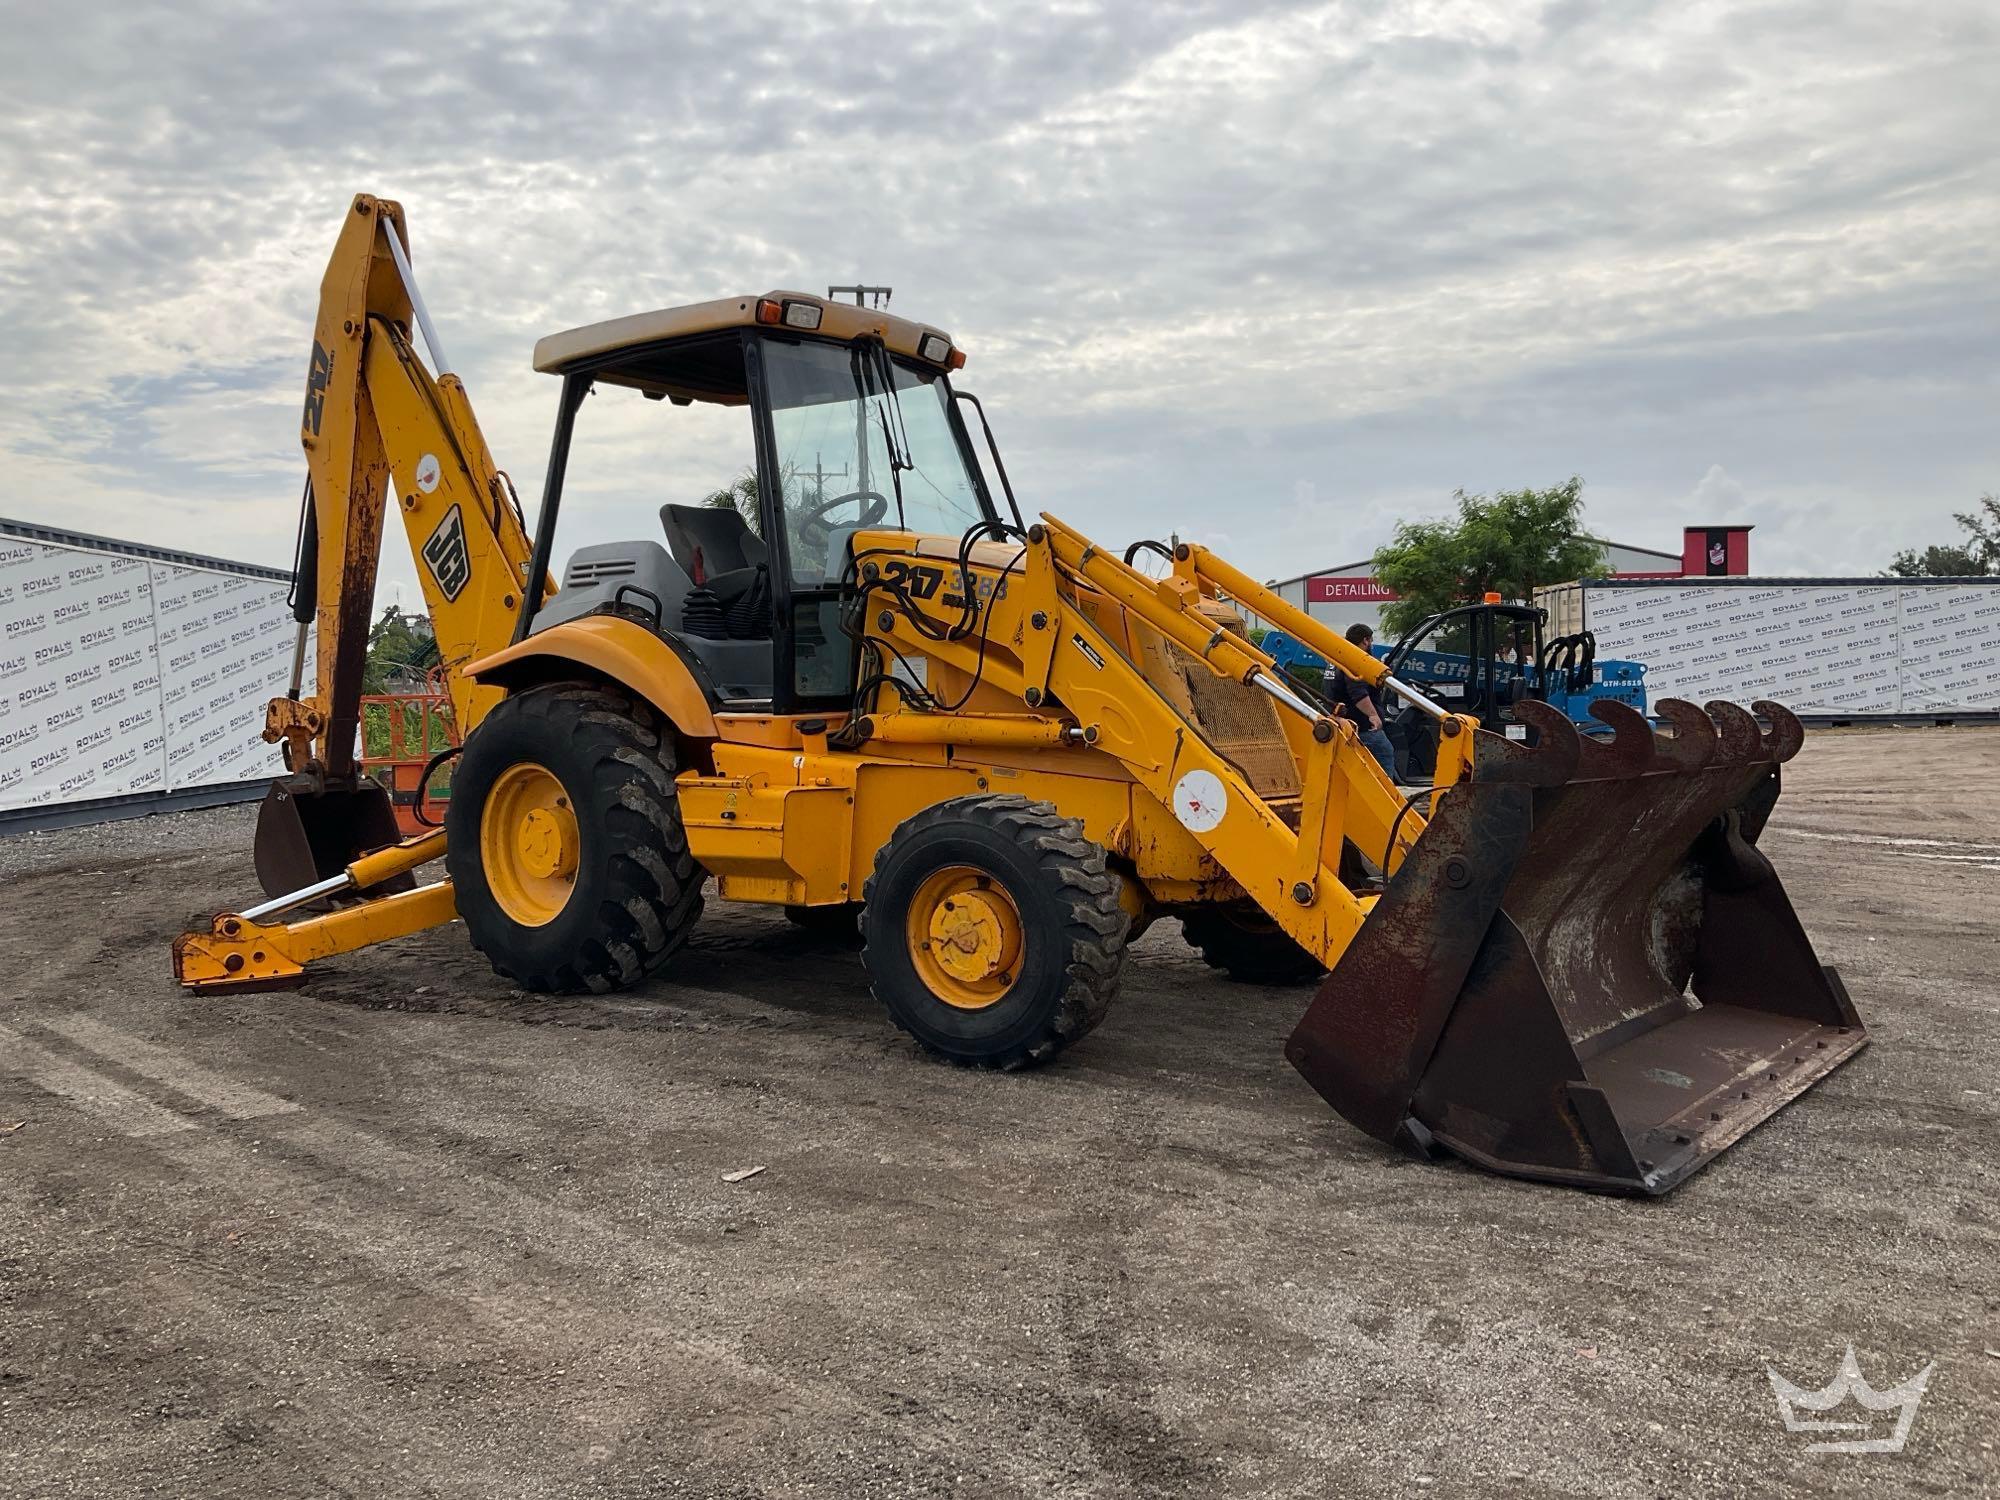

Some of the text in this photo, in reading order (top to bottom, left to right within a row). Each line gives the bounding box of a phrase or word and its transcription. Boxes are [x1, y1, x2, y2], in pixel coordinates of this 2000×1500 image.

[0, 549, 24, 560] OYAL
[425, 516, 466, 595] JCB
[69, 568, 96, 579] ROYAL
[882, 561, 944, 599] 217
[23, 579, 53, 592] ROYAL
[138, 584, 152, 593] ROY
[1325, 583, 1390, 597] DETAILING
[193, 588, 213, 598] ROYAL
[270, 590, 287, 599] ROYAL
[1680, 590, 1706, 598] ROYAL
[1749, 592, 1775, 600] ROYAL
[98, 592, 123, 605] ROYAL
[1636, 598, 1662, 606] ROYAL
[1815, 595, 1841, 603] ROYAL
[1949, 595, 1975, 604] ROYAL
[160, 599, 182, 609] ROYAL
[243, 600, 261, 609] ROYAL
[1706, 601, 1732, 609] ROYAL
[1772, 604, 1799, 612] ROYAL
[1907, 604, 1933, 613] ROYAL
[54, 605, 82, 618] ROYAL
[213, 609, 233, 620] ROYAL
[1593, 608, 1618, 616] ROYAL
[1663, 610, 1689, 618] ROYAL
[1841, 606, 1866, 615] ROYAL
[1730, 613, 1756, 621] ROYAL
[1799, 615, 1824, 624] ROYAL
[1933, 615, 1958, 624] ROYAL
[6, 617, 37, 632] ROYAL
[122, 617, 147, 630] ROYAL
[182, 620, 203, 631] ROYAL
[260, 620, 277, 630] ROYAL
[1619, 618, 1645, 627] ROYAL
[1686, 622, 1712, 630] ROYAL
[1864, 618, 1889, 627] ROYAL
[1756, 624, 1782, 632] ROYAL
[1822, 628, 1848, 636] ROYAL
[1955, 627, 1980, 636] ROYAL
[81, 629, 108, 644] ROYAL
[160, 632, 172, 640] YAL
[231, 631, 251, 641] ROYAL
[1642, 630, 1669, 639] ROYAL
[1712, 633, 1738, 641] ROYAL
[278, 639, 294, 650] ROYAL
[1600, 640, 1625, 648] ROYAL
[1779, 636, 1805, 645] ROYAL
[1847, 639, 1873, 648] ROYAL
[1913, 636, 1939, 645] ROYAL
[201, 641, 222, 653] ROYAL
[1669, 643, 1695, 651] ROYAL
[1736, 646, 1762, 654] ROYAL
[1939, 647, 1964, 656] ROYAL
[35, 644, 64, 660] ROYAL
[251, 650, 269, 661] ROYAL
[1626, 652, 1652, 660] ROYAL
[1805, 648, 1831, 656] ROYAL
[1870, 650, 1896, 659] ROYAL
[109, 653, 134, 667] ROYAL
[171, 653, 191, 667] ROYAL
[1692, 654, 1719, 662] ROYAL
[1762, 657, 1788, 665] ROYAL
[1902, 656, 1922, 664] OYAL
[0, 660, 18, 671] YAL
[222, 661, 241, 673] ROYAL
[1649, 664, 1676, 672] ROYAL
[1828, 660, 1854, 668] ROYAL
[1961, 660, 1986, 668] ROYAL
[1718, 665, 1744, 674] ROYAL
[1785, 669, 1812, 678] ROYAL
[1920, 668, 1945, 678] ROYAL
[65, 670, 94, 684] ROYAL
[268, 669, 284, 680] ROYAL
[1676, 674, 1702, 684] ROYAL
[1853, 672, 1878, 680] ROYAL
[133, 677, 158, 690] ROYAL
[191, 673, 212, 688] ROYAL
[1742, 678, 1767, 686] ROYAL
[1811, 680, 1837, 688] ROYAL
[1944, 680, 1970, 689] ROYAL
[240, 681, 258, 694] ROYAL
[1698, 686, 1725, 696] ROYAL
[1876, 684, 1897, 692] ROYA
[19, 685, 49, 701] ROYAL
[166, 688, 181, 700] OYAL
[1768, 689, 1794, 698] ROYAL
[1833, 692, 1859, 700] ROYAL
[1903, 688, 1928, 697] ROYAL
[1967, 691, 1992, 700] ROYAL
[92, 693, 118, 708] ROYAL
[210, 694, 229, 708] ROYAL
[1925, 700, 1951, 709] ROYAL
[1790, 702, 1817, 710] ROYAL
[47, 709, 75, 726] ROYAL
[179, 709, 199, 723] ROYAL
[230, 713, 250, 727] ROYAL
[119, 714, 145, 729] ROYAL
[77, 732, 104, 748] ROYAL
[200, 728, 220, 743] ROYAL
[144, 737, 164, 751] ROYA
[169, 744, 190, 760] ROYAL
[218, 747, 238, 762] ROYAL
[267, 750, 281, 762] ROYA
[31, 751, 61, 770] ROYAL
[103, 753, 129, 770] ROYAL
[188, 764, 209, 780] ROYAL
[240, 764, 257, 778] ROYAL
[60, 773, 87, 792] ROYAL
[130, 773, 154, 789] ROYAL
